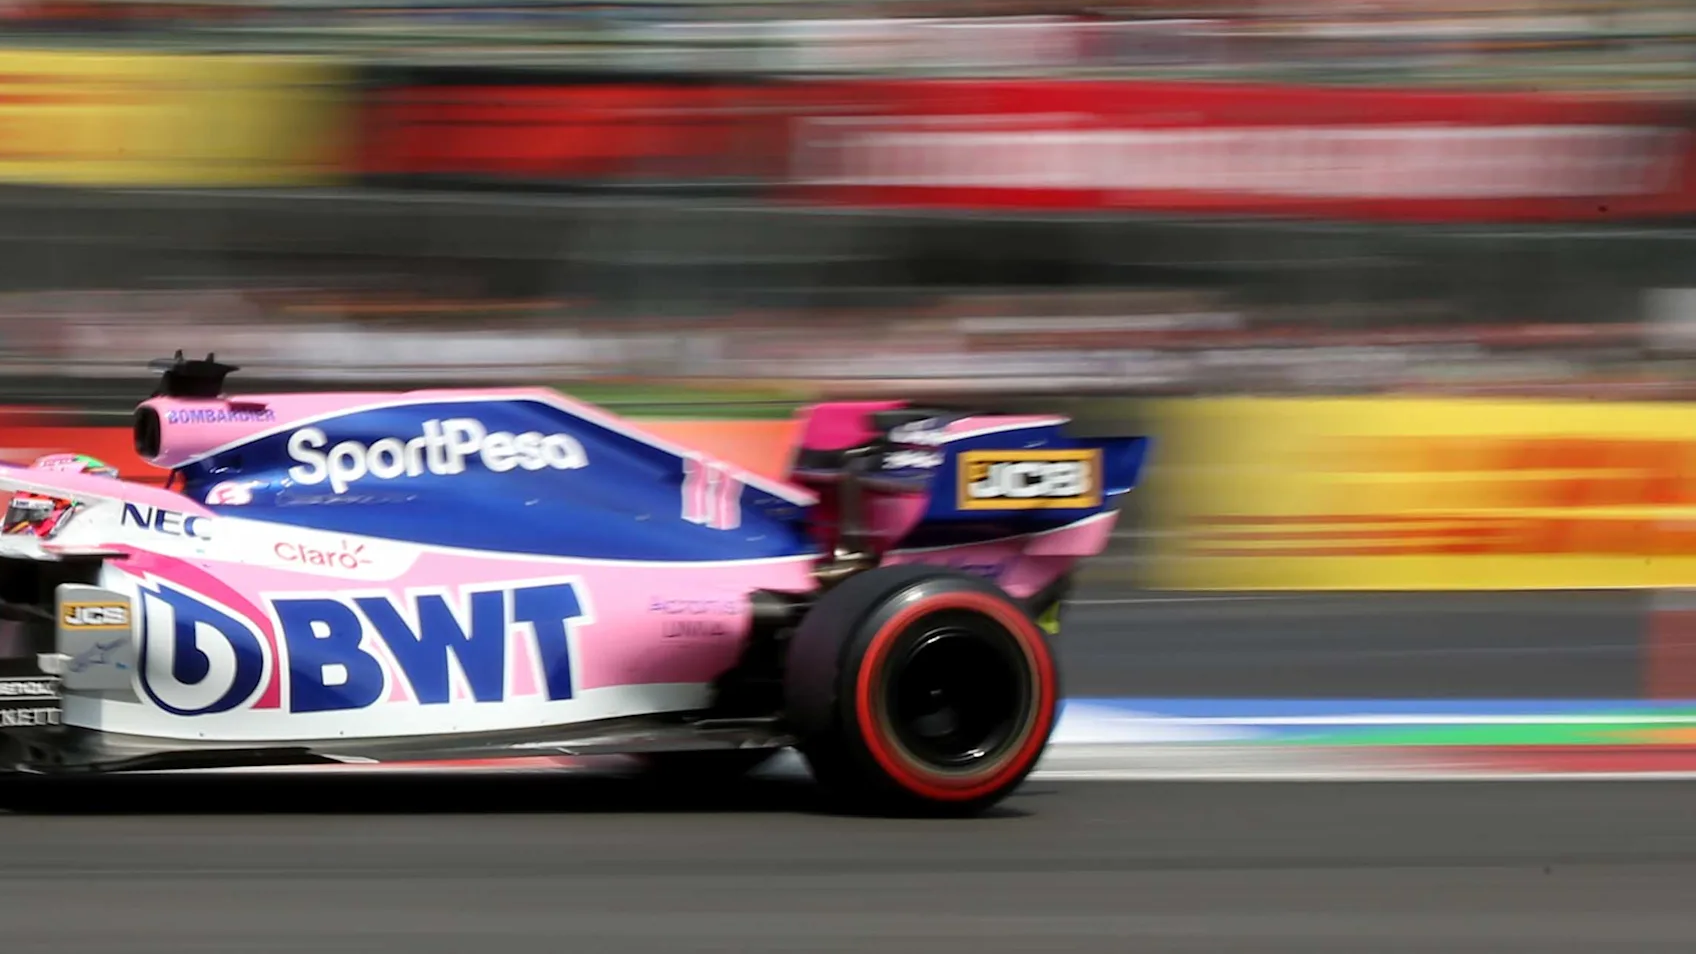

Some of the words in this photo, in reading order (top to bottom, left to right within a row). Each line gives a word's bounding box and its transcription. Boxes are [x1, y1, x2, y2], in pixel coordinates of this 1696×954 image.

[167, 408, 276, 424] BOMBARDIER
[287, 418, 588, 493] SportPesa
[968, 461, 1092, 498] JCB
[121, 502, 211, 541] NEC
[274, 542, 358, 570] Claro
[271, 583, 583, 712] BWT
